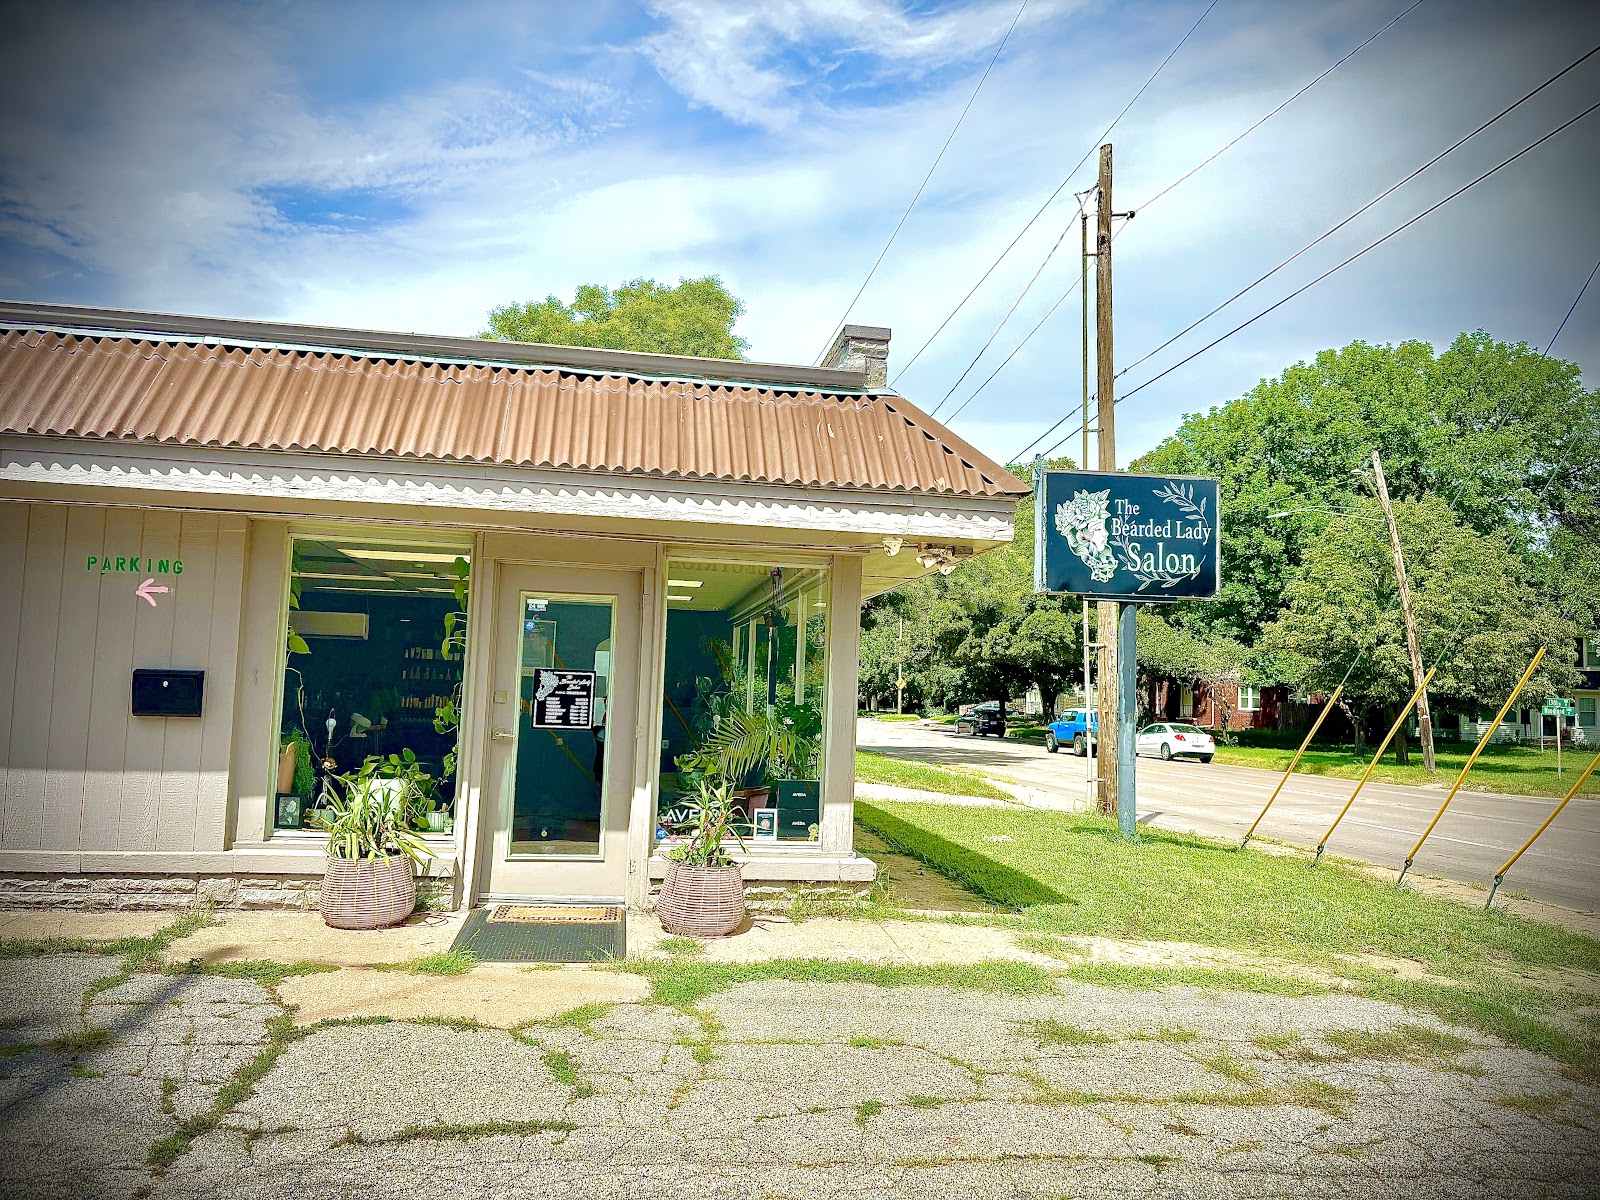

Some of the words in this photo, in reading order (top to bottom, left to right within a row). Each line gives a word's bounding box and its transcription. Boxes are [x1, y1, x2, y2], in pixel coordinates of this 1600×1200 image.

[1115, 499, 1140, 515] The
[1112, 518, 1172, 538] Bearded
[1175, 521, 1212, 546] Lady
[87, 556, 184, 575] PARKING
[1128, 542, 1197, 574] Salon
